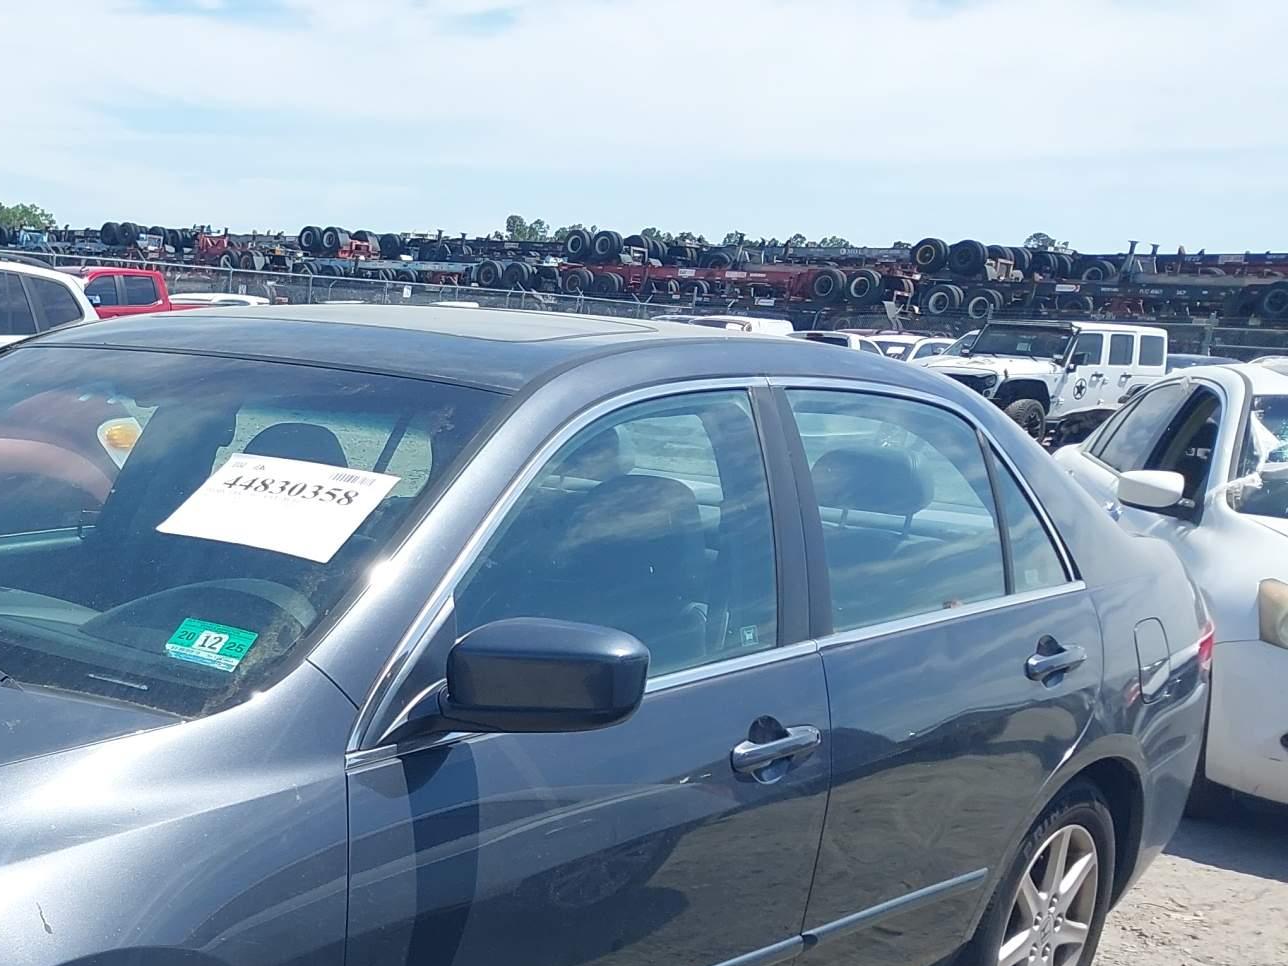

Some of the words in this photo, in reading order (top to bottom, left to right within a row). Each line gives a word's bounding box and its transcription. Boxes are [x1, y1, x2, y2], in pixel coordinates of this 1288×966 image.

[223, 475, 360, 506] 44830358
[177, 630, 196, 641] 20
[198, 635, 223, 650] 12
[225, 641, 246, 653] 25
